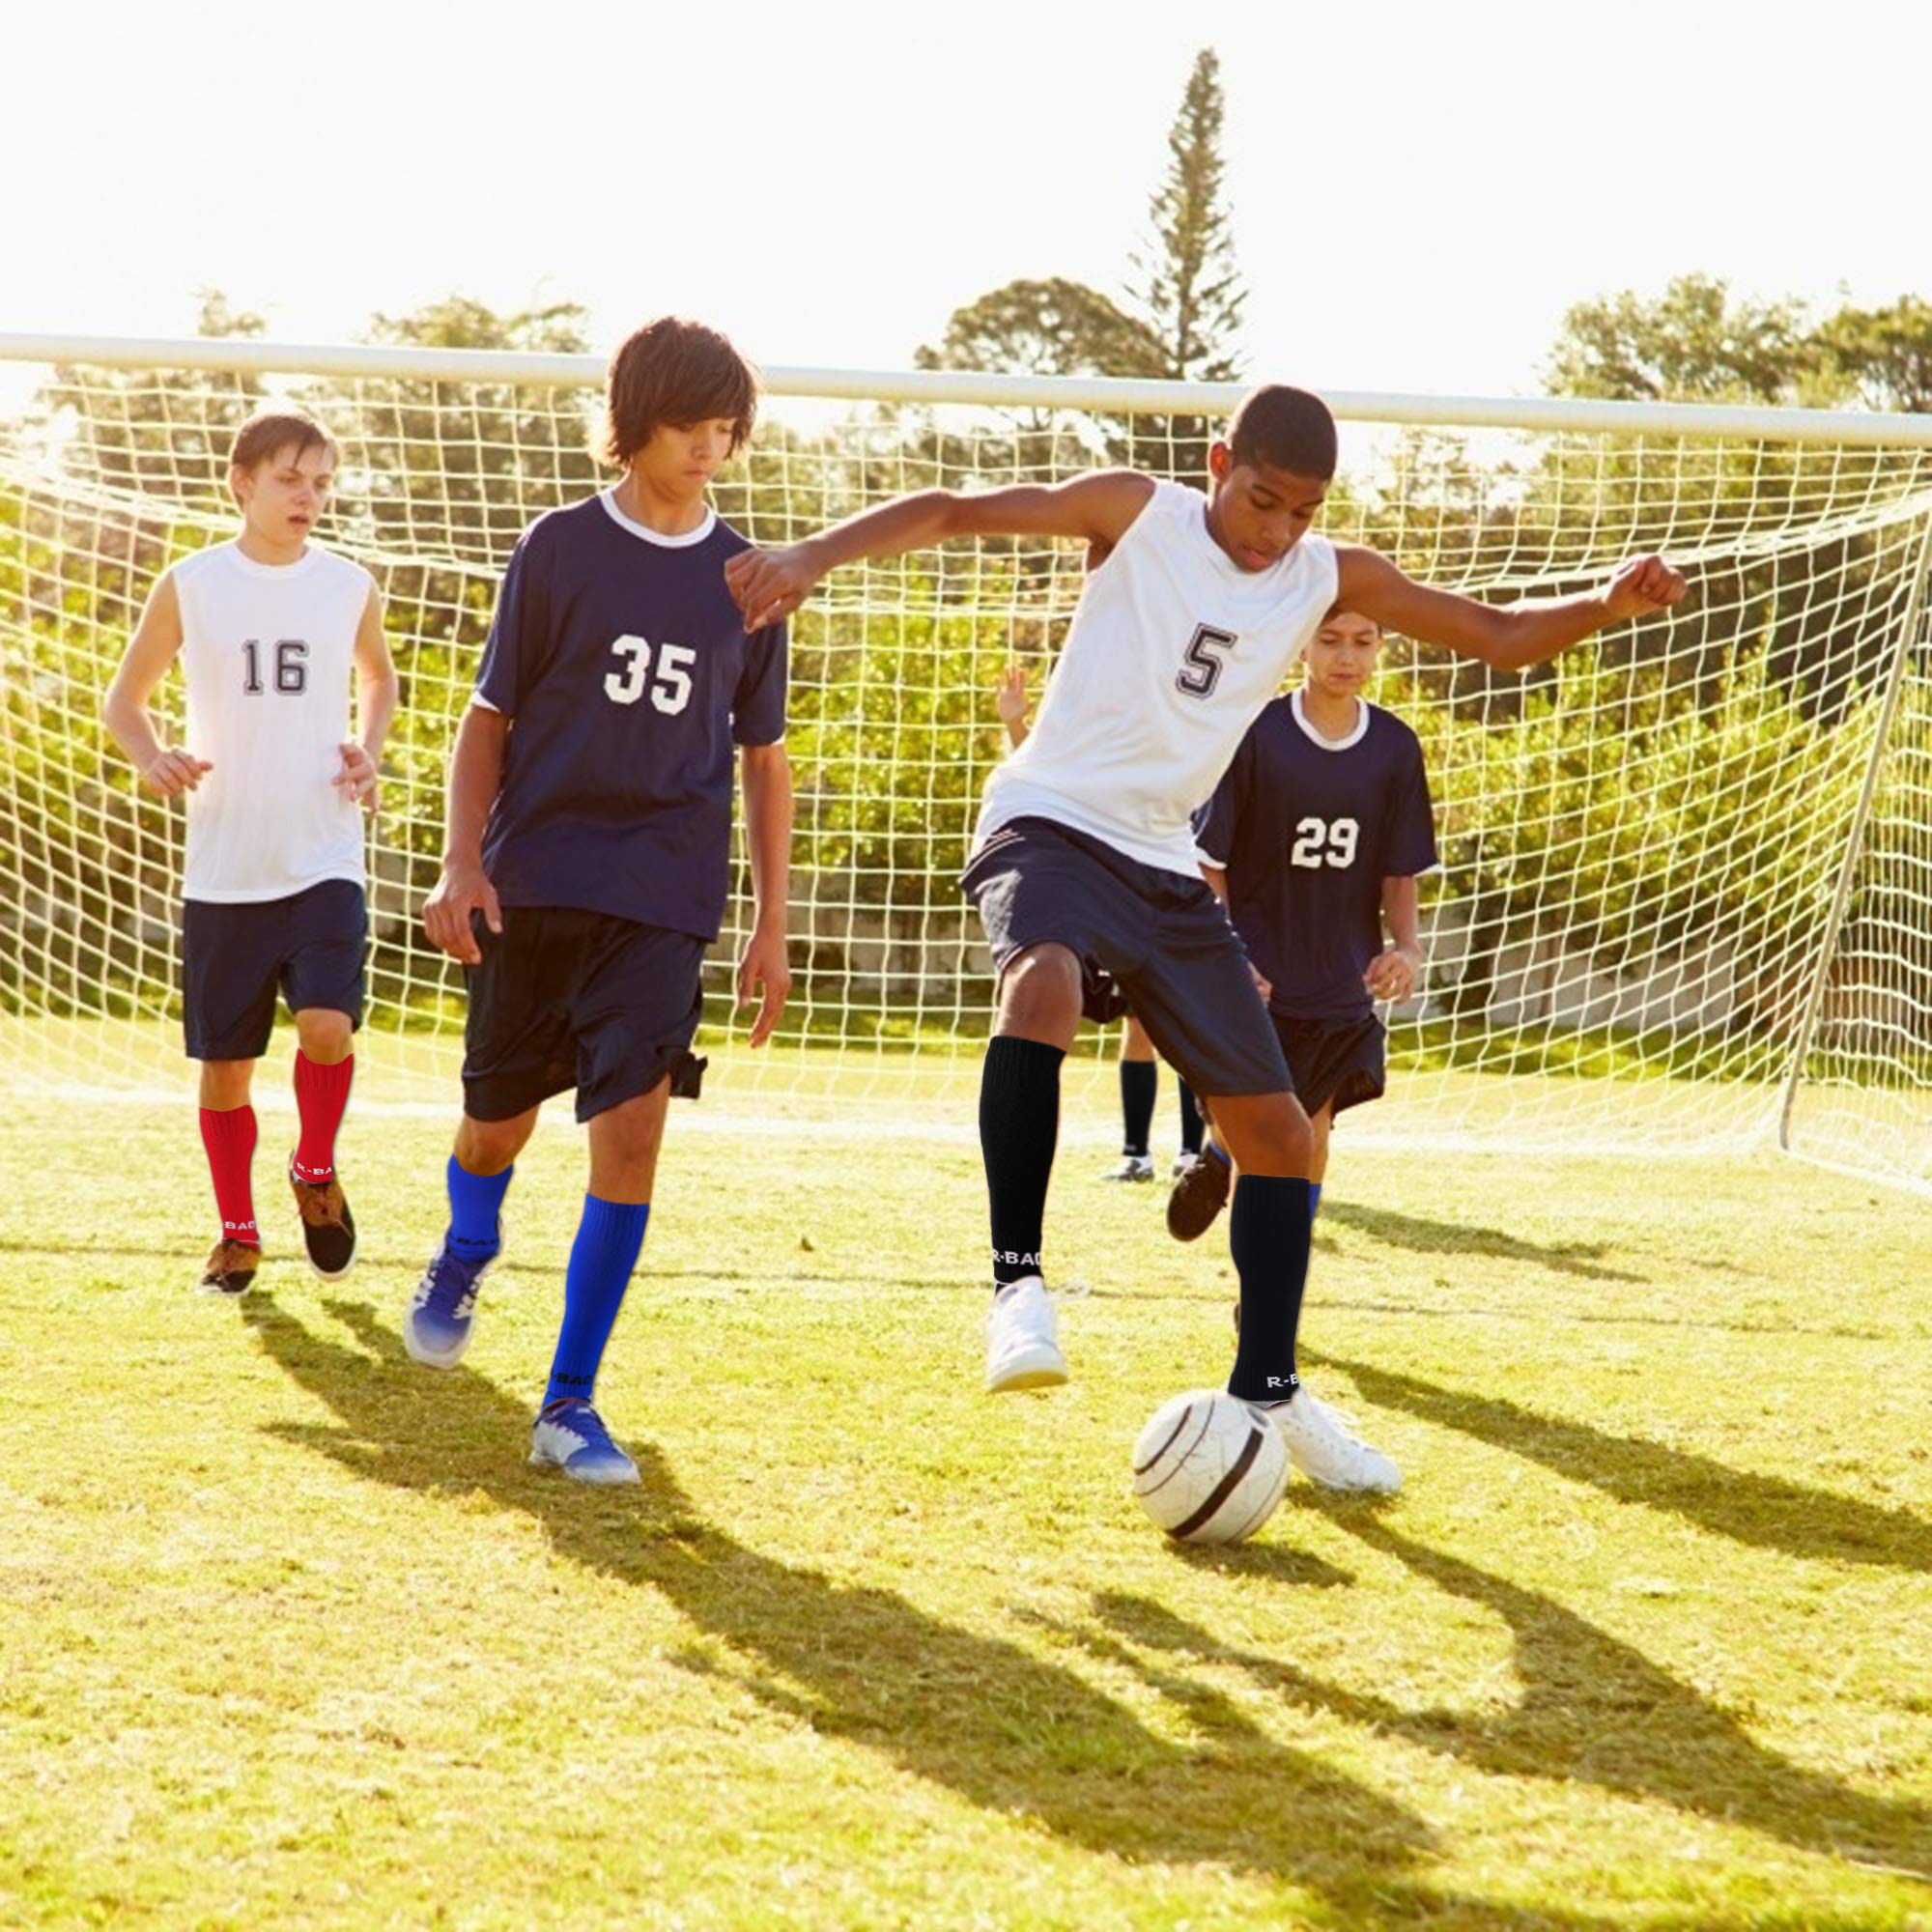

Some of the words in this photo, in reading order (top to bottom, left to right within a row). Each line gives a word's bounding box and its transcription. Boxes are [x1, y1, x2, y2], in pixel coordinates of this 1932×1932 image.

[242, 639, 309, 696] 16
[604, 634, 696, 715] 35
[1176, 622, 1238, 700] 5
[1292, 817, 1360, 868] 29
